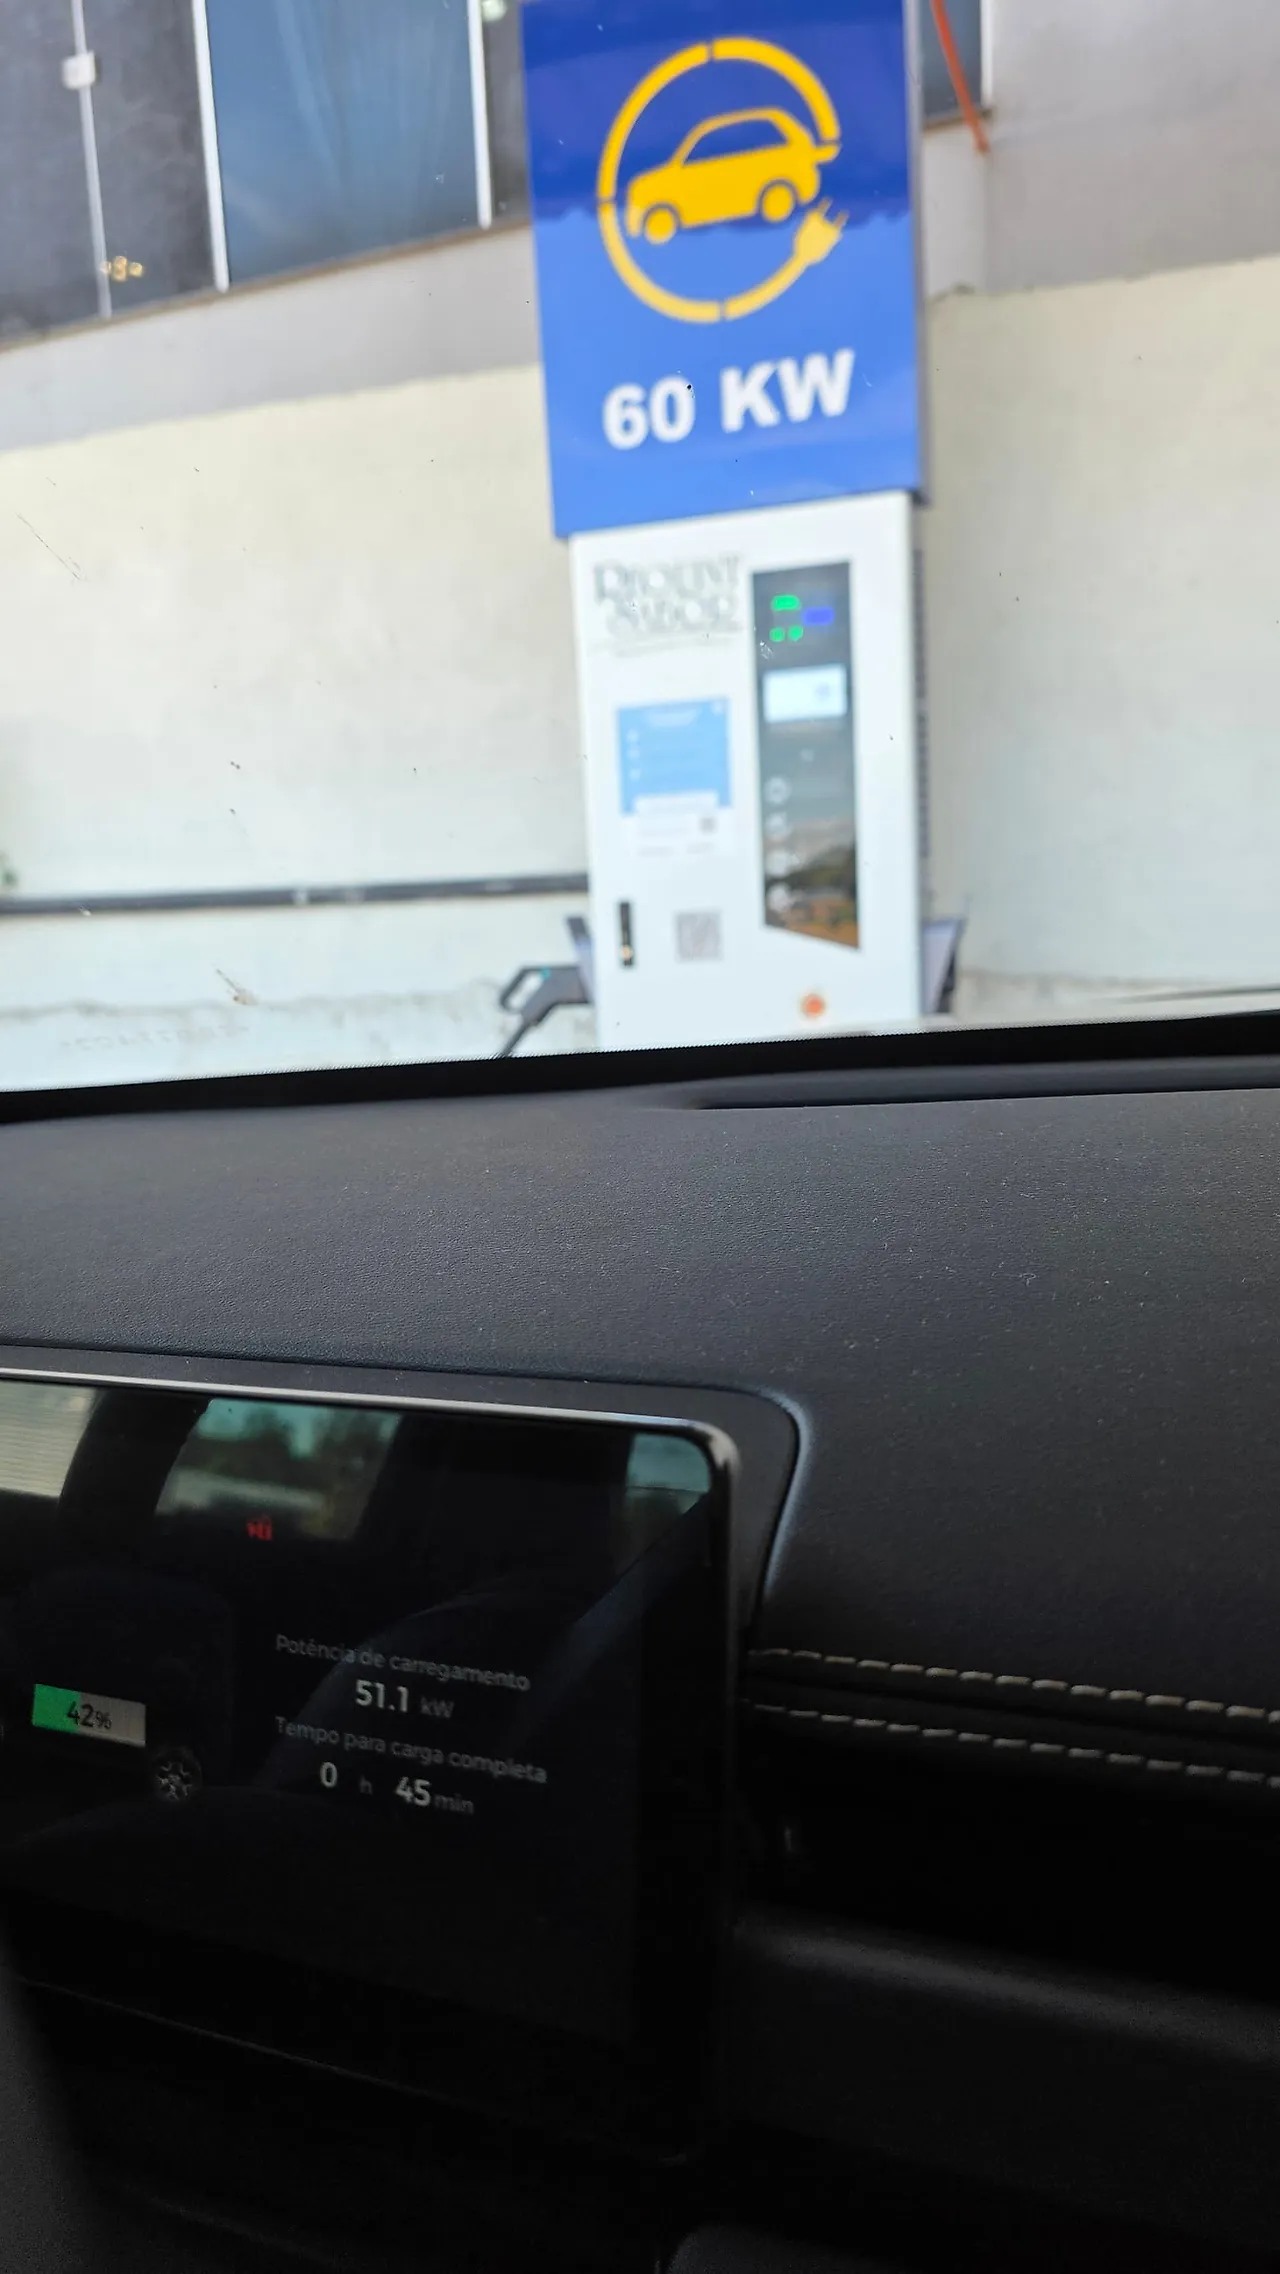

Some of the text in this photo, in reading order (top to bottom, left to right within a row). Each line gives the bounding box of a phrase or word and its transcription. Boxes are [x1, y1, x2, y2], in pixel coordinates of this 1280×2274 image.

[602, 347, 855, 450] 60 KW
[360, 1647, 385, 1668] de
[389, 1654, 531, 1692] carregamento
[66, 1701, 112, 1730] 42%
[355, 1678, 456, 1720] 51.1 kW
[274, 1715, 548, 1784] Tempo para carga completa
[319, 1760, 338, 1789] 0
[358, 1774, 374, 1796] h
